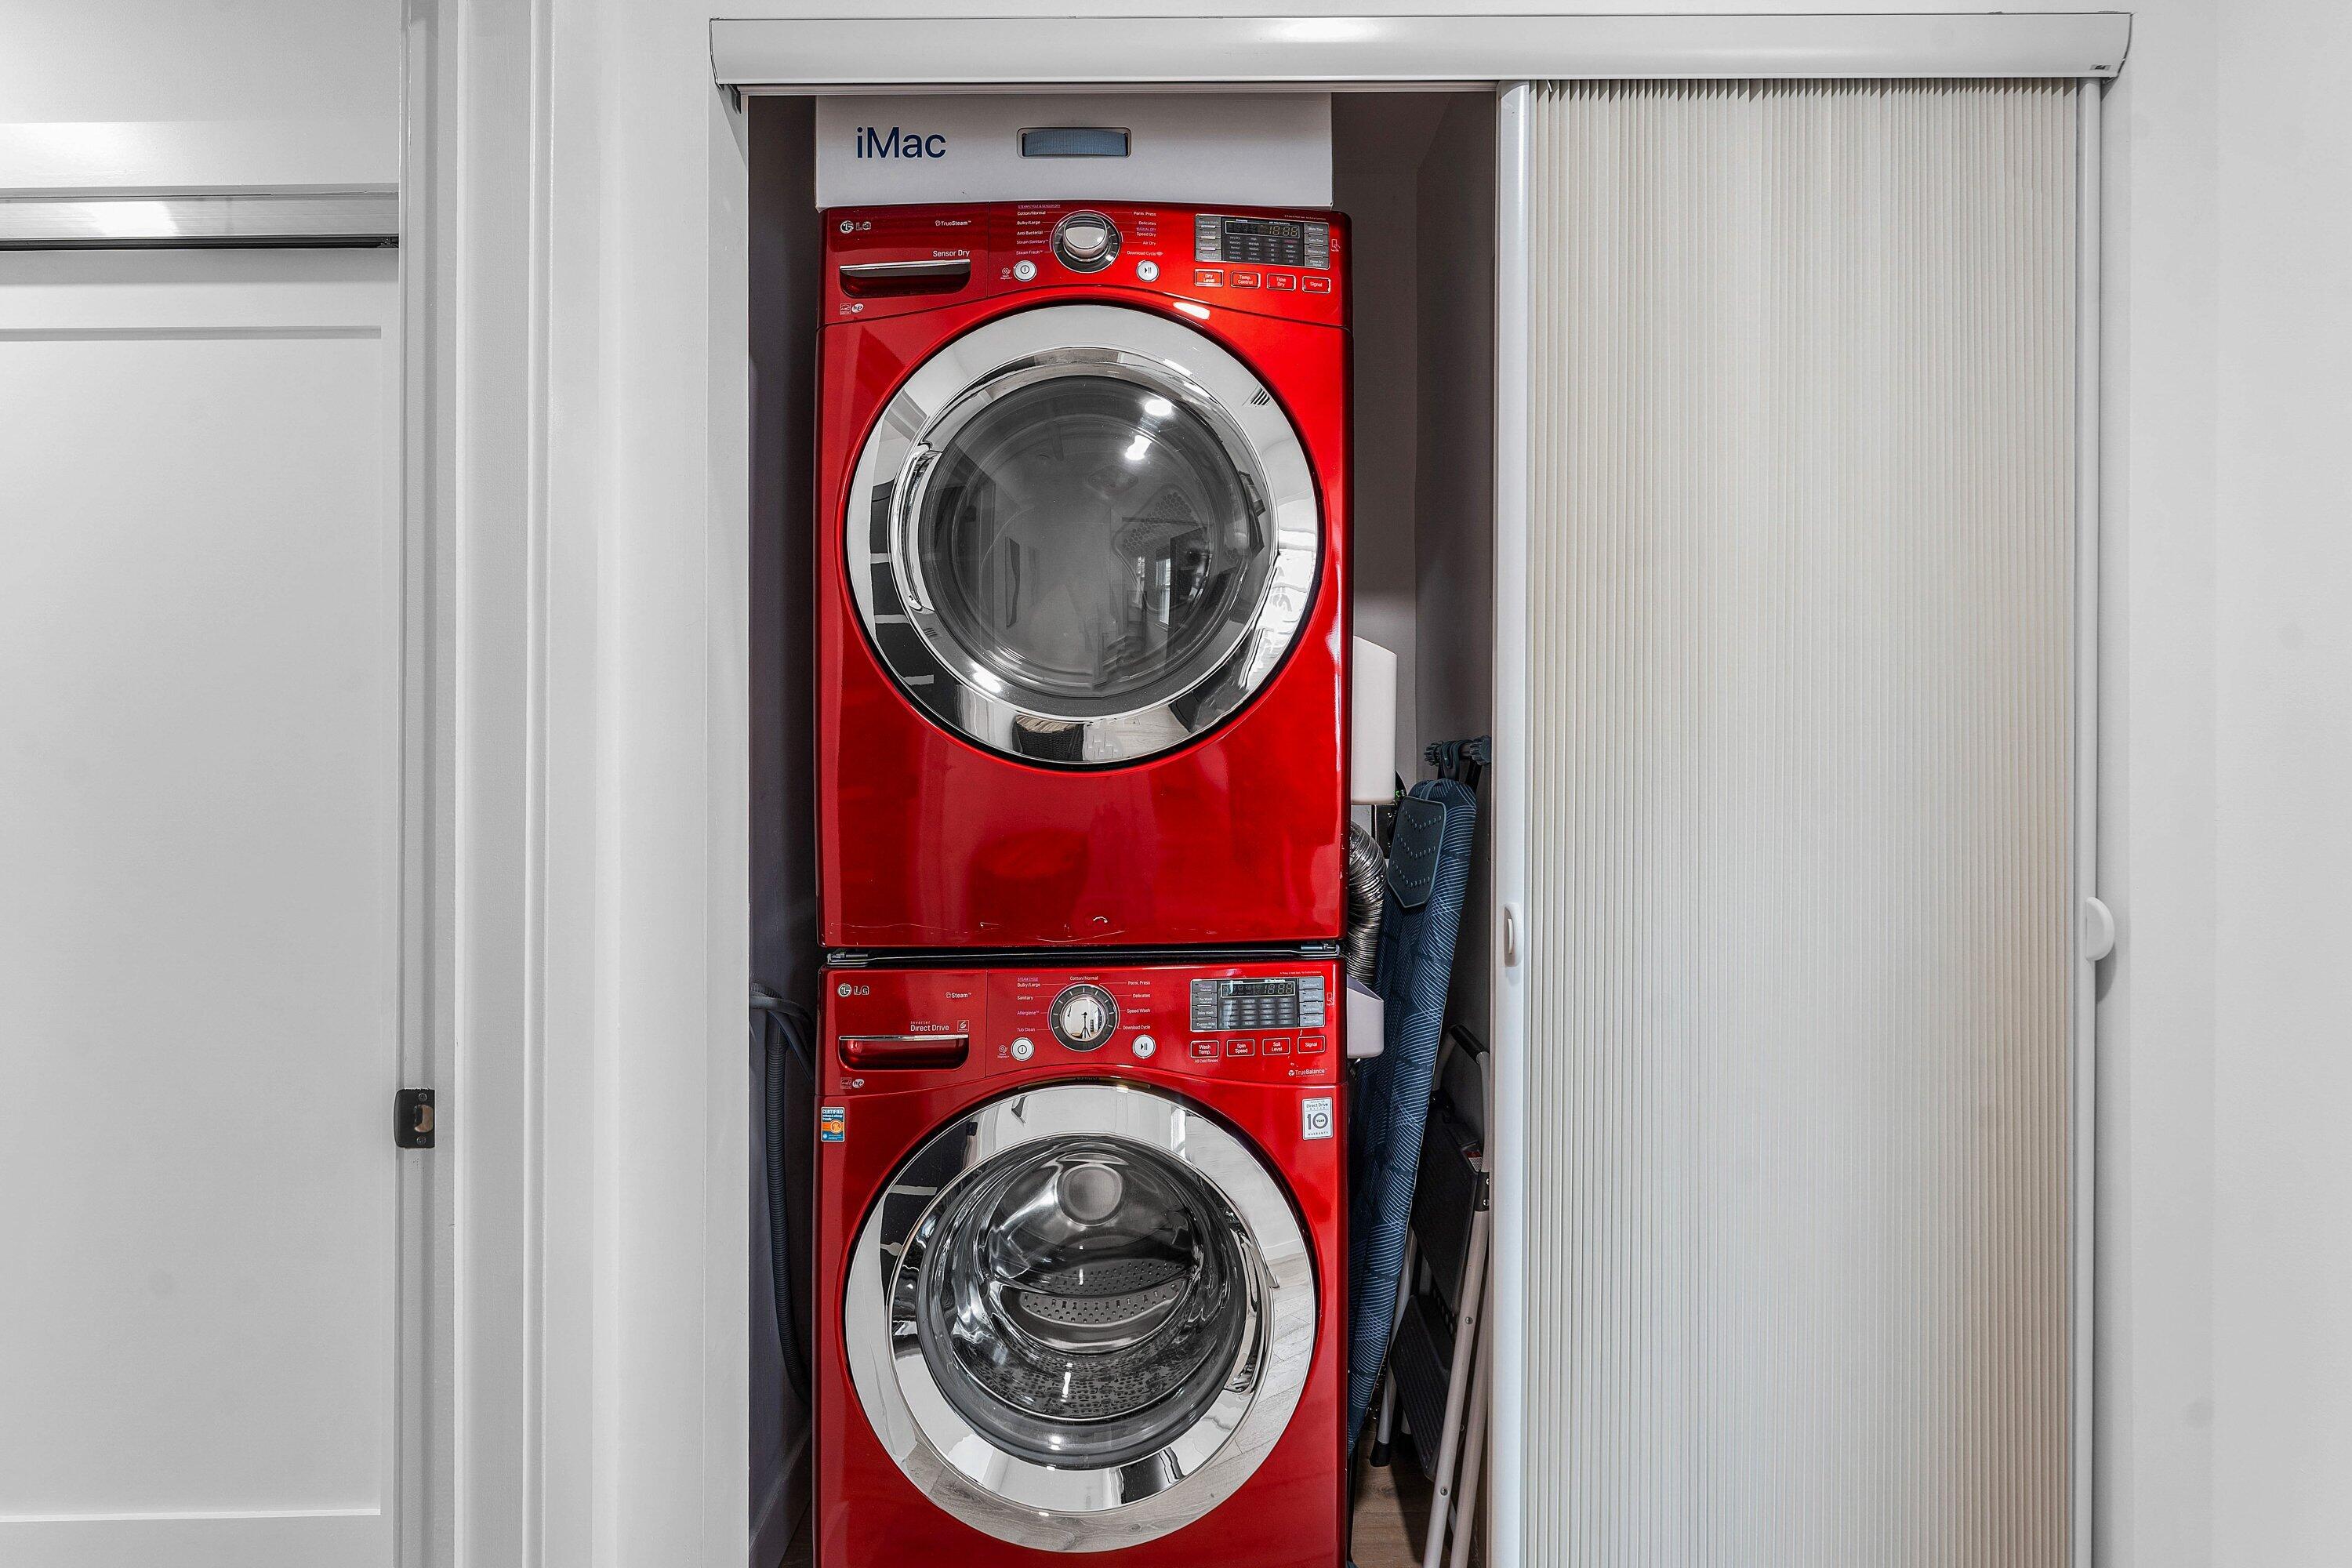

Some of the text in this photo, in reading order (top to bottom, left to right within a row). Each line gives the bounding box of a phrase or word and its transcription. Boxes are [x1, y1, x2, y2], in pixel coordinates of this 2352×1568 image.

[857, 126, 946, 158] iMac
[855, 221, 872, 230] LG
[854, 985, 869, 995] LG
[1307, 1112, 1328, 1130] 10
